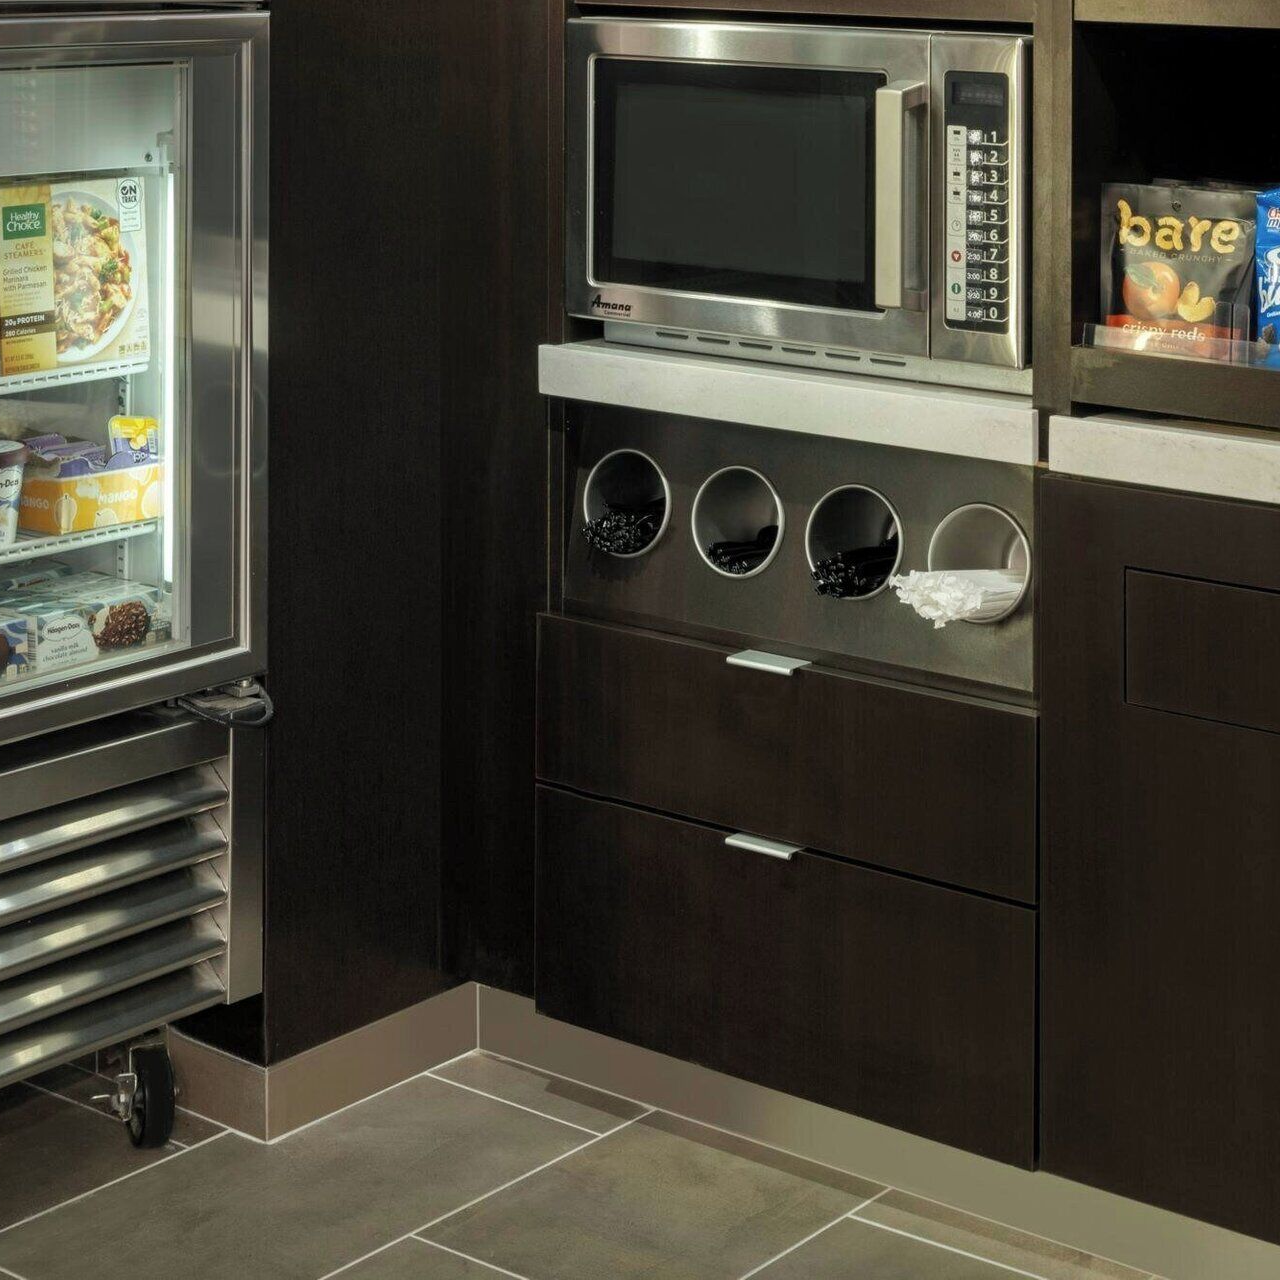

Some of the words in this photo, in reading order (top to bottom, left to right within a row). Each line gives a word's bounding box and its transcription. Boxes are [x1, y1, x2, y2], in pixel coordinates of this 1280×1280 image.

[990, 151, 998, 163] 2
[990, 170, 998, 182] 3
[121, 185, 137, 196] ON
[990, 190, 998, 202] 4
[121, 195, 138, 204] TRACK
[10, 211, 40, 223] Healthy
[990, 209, 998, 221] 5
[6, 220, 41, 232] Choice
[1118, 198, 1240, 254] bare
[990, 229, 998, 241] 6
[3, 249, 43, 260] STEAMERS
[990, 249, 998, 260] 7
[990, 268, 998, 280] 8
[990, 288, 998, 300] 9
[591, 294, 632, 312] Amana
